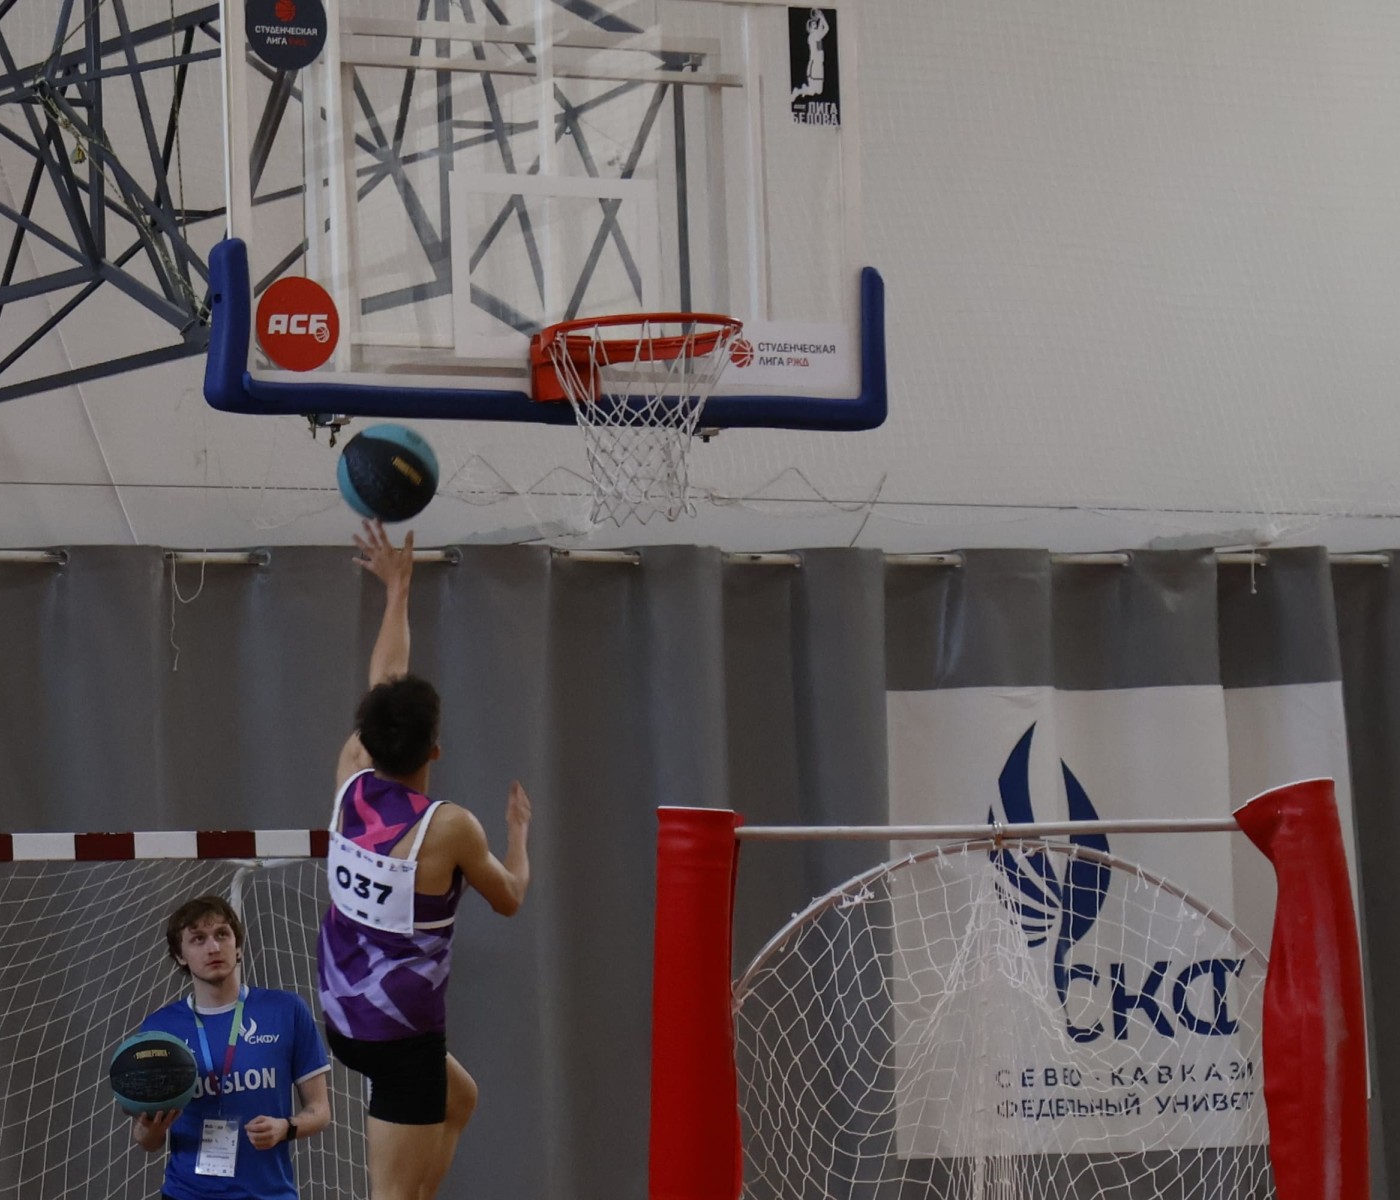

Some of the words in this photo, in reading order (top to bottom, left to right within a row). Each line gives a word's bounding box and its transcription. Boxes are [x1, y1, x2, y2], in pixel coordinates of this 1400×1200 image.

[255, 25, 318, 36] СТУДЕНЧЕСКАЯ
[266, 37, 287, 46] ЛИГА
[808, 101, 838, 115] ЛИГА
[792, 112, 839, 126] БЕЛОВА
[758, 342, 836, 354] СТУДЕНЧЕСКАЯ
[758, 357, 784, 366] ЛИГА
[786, 357, 809, 367] РЖД
[335, 865, 393, 905] 037
[248, 1034, 280, 1045] СКФУ
